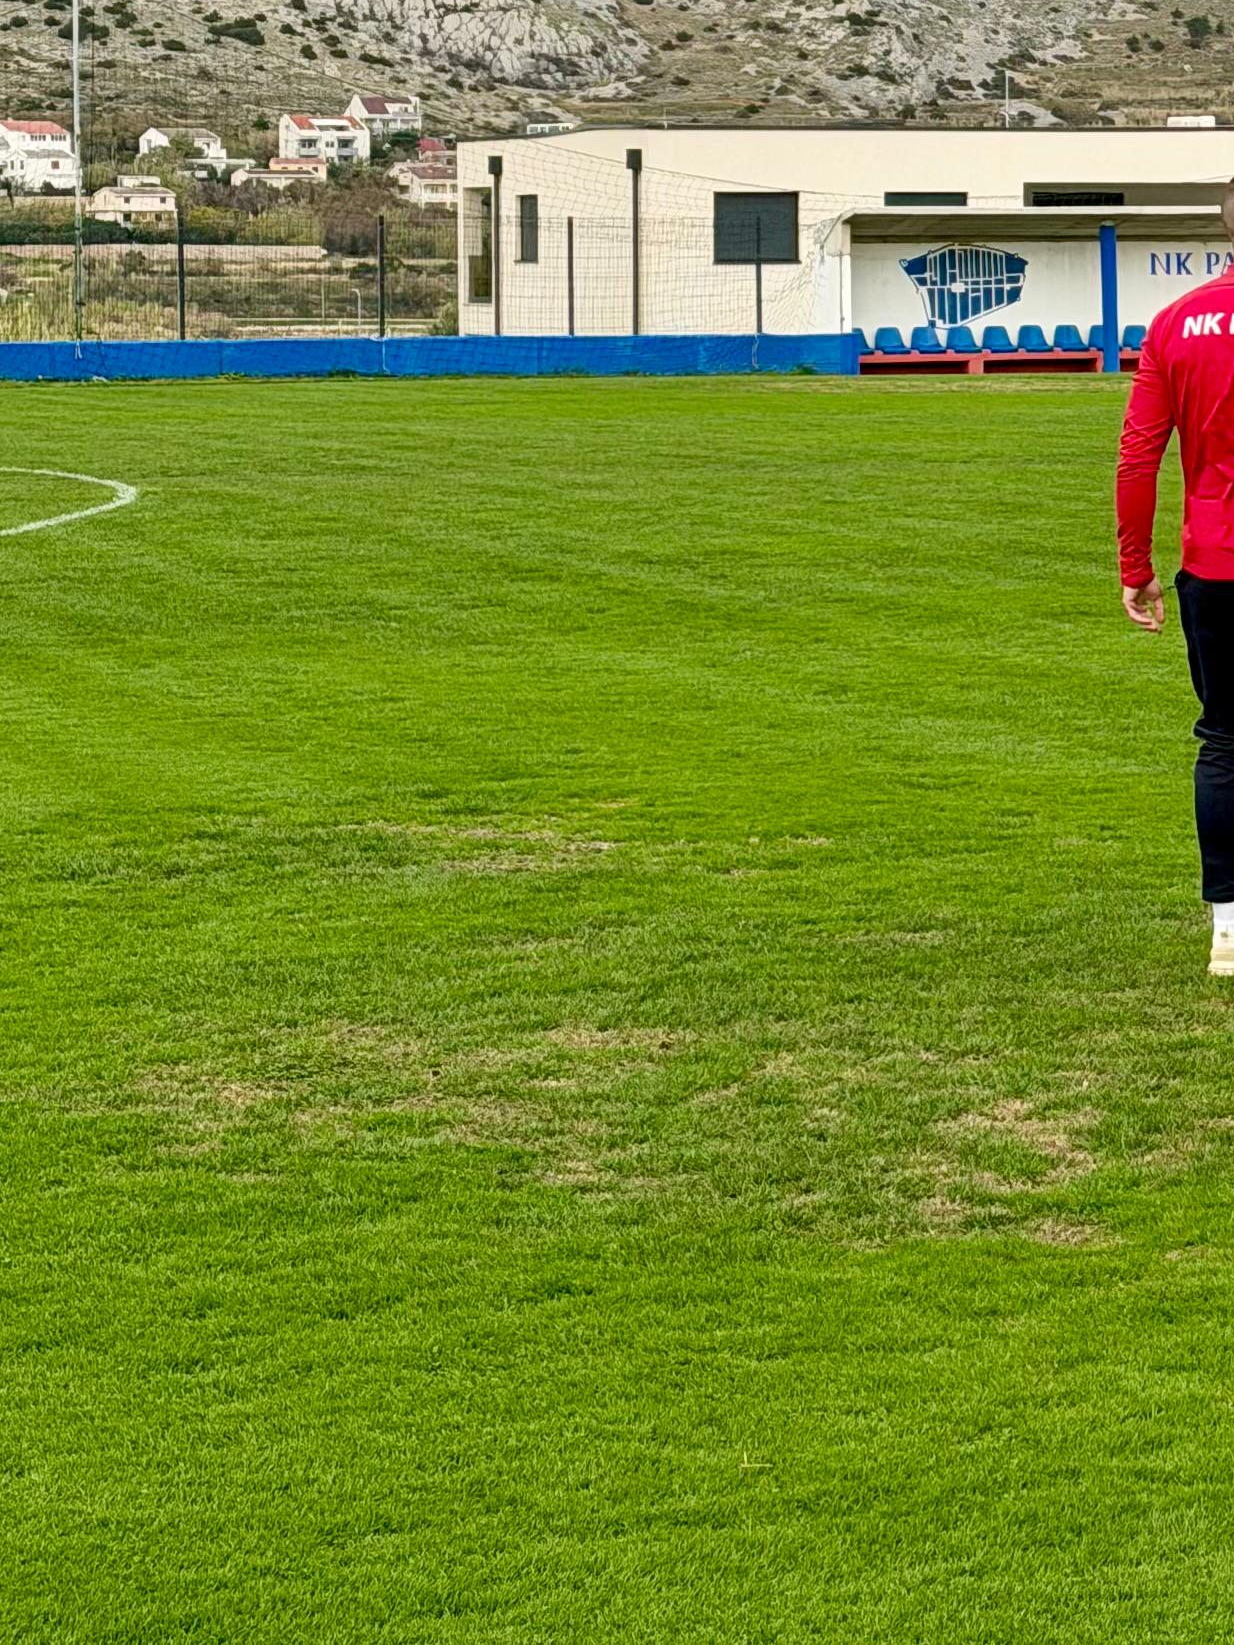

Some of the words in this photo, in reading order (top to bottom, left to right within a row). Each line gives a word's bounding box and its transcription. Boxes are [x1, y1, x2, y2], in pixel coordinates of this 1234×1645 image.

[1150, 252, 1193, 275] NK
[1205, 251, 1234, 275] PA
[1182, 312, 1226, 339] NK
